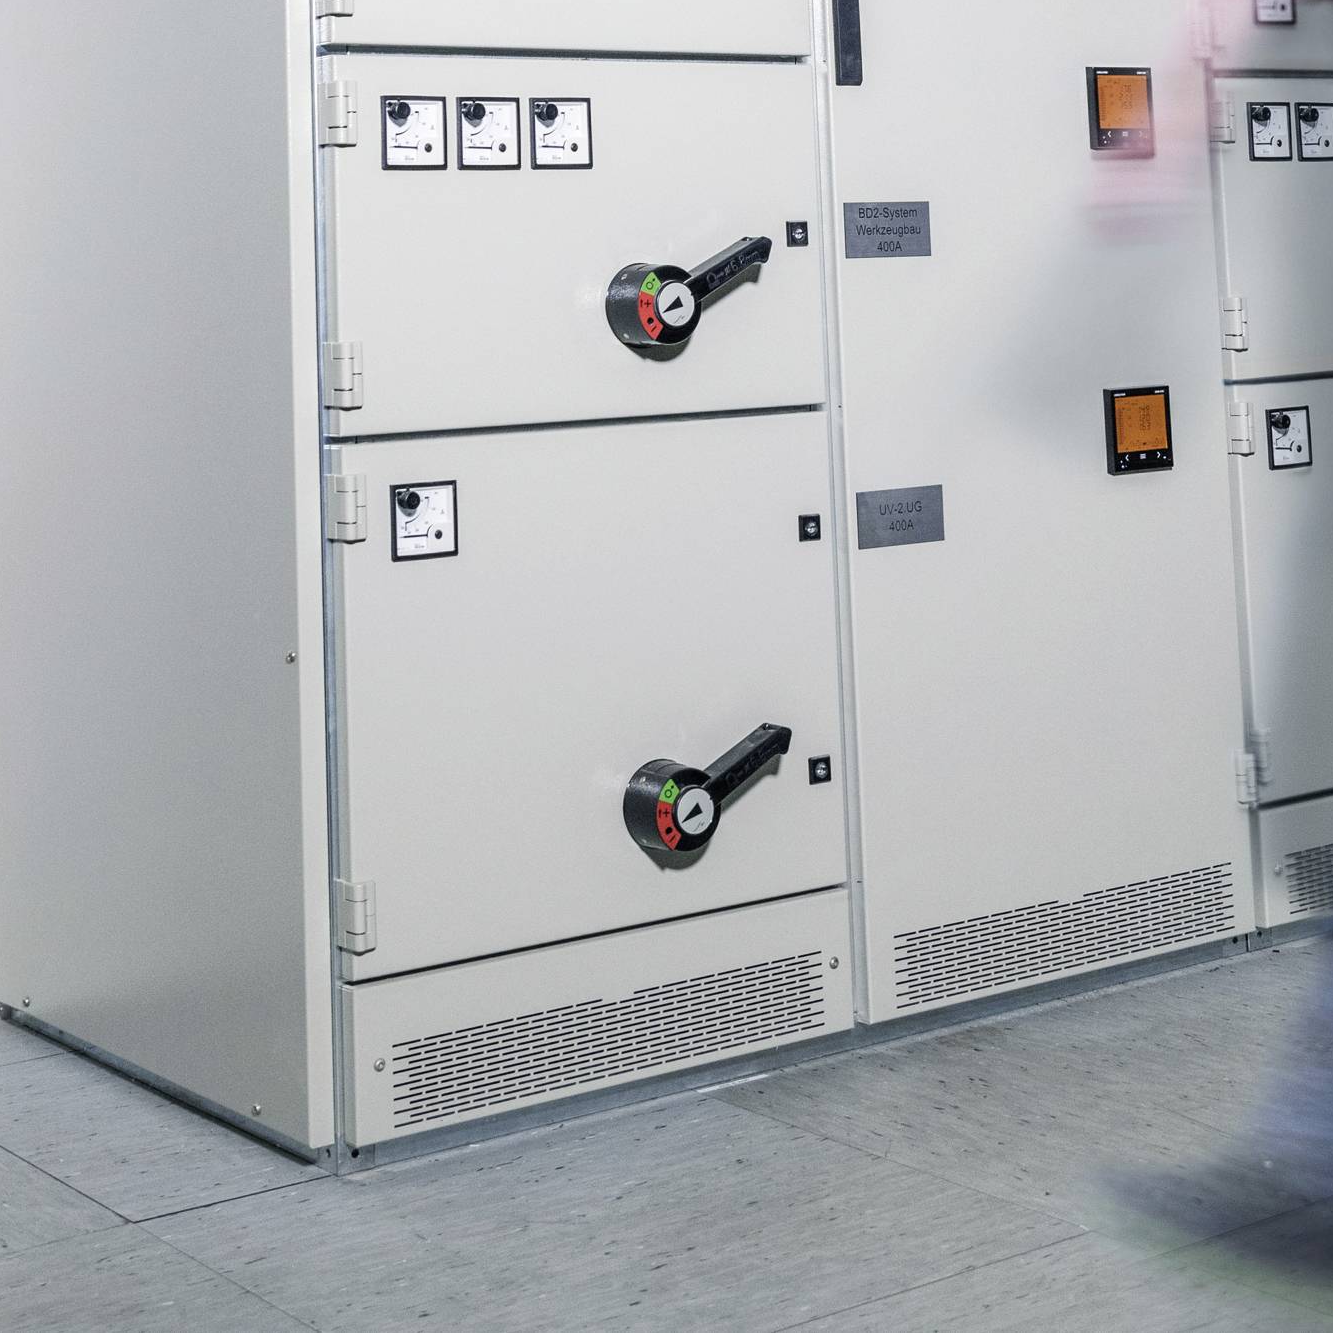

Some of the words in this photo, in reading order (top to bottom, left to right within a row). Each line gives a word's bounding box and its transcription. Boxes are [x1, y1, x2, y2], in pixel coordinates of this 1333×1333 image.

[858, 207, 918, 221] BD2-System
[855, 223, 921, 237] Werkzeugbau
[876, 241, 903, 252] 400A
[879, 500, 923, 516] UV-2.UG
[888, 519, 914, 532] 400A
